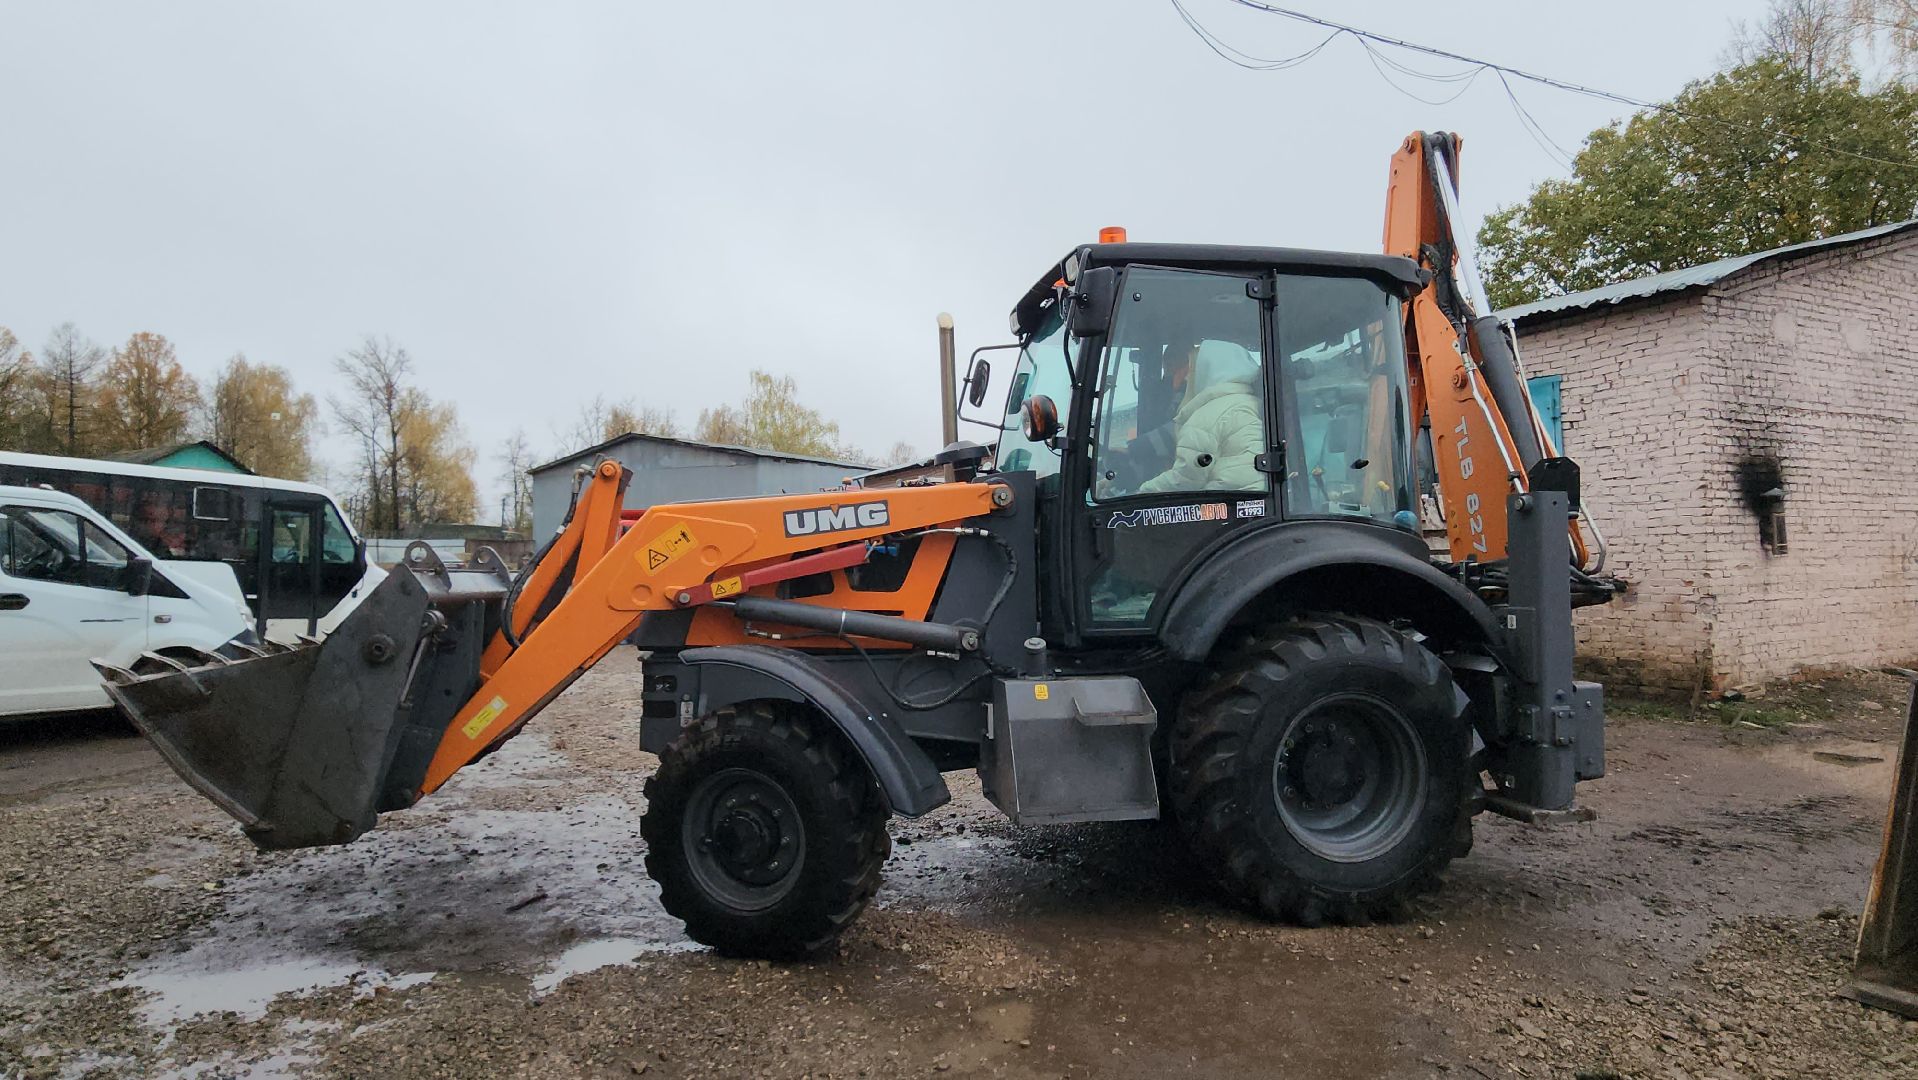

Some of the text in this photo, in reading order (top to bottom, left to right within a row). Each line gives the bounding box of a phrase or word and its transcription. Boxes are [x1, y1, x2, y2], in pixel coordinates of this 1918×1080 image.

[1455, 415, 1488, 553] TLB 827
[785, 503, 888, 535] UMG
[1143, 503, 1228, 526] РУСБИЗНЕСАВТО
[1244, 507, 1263, 516] 1993
